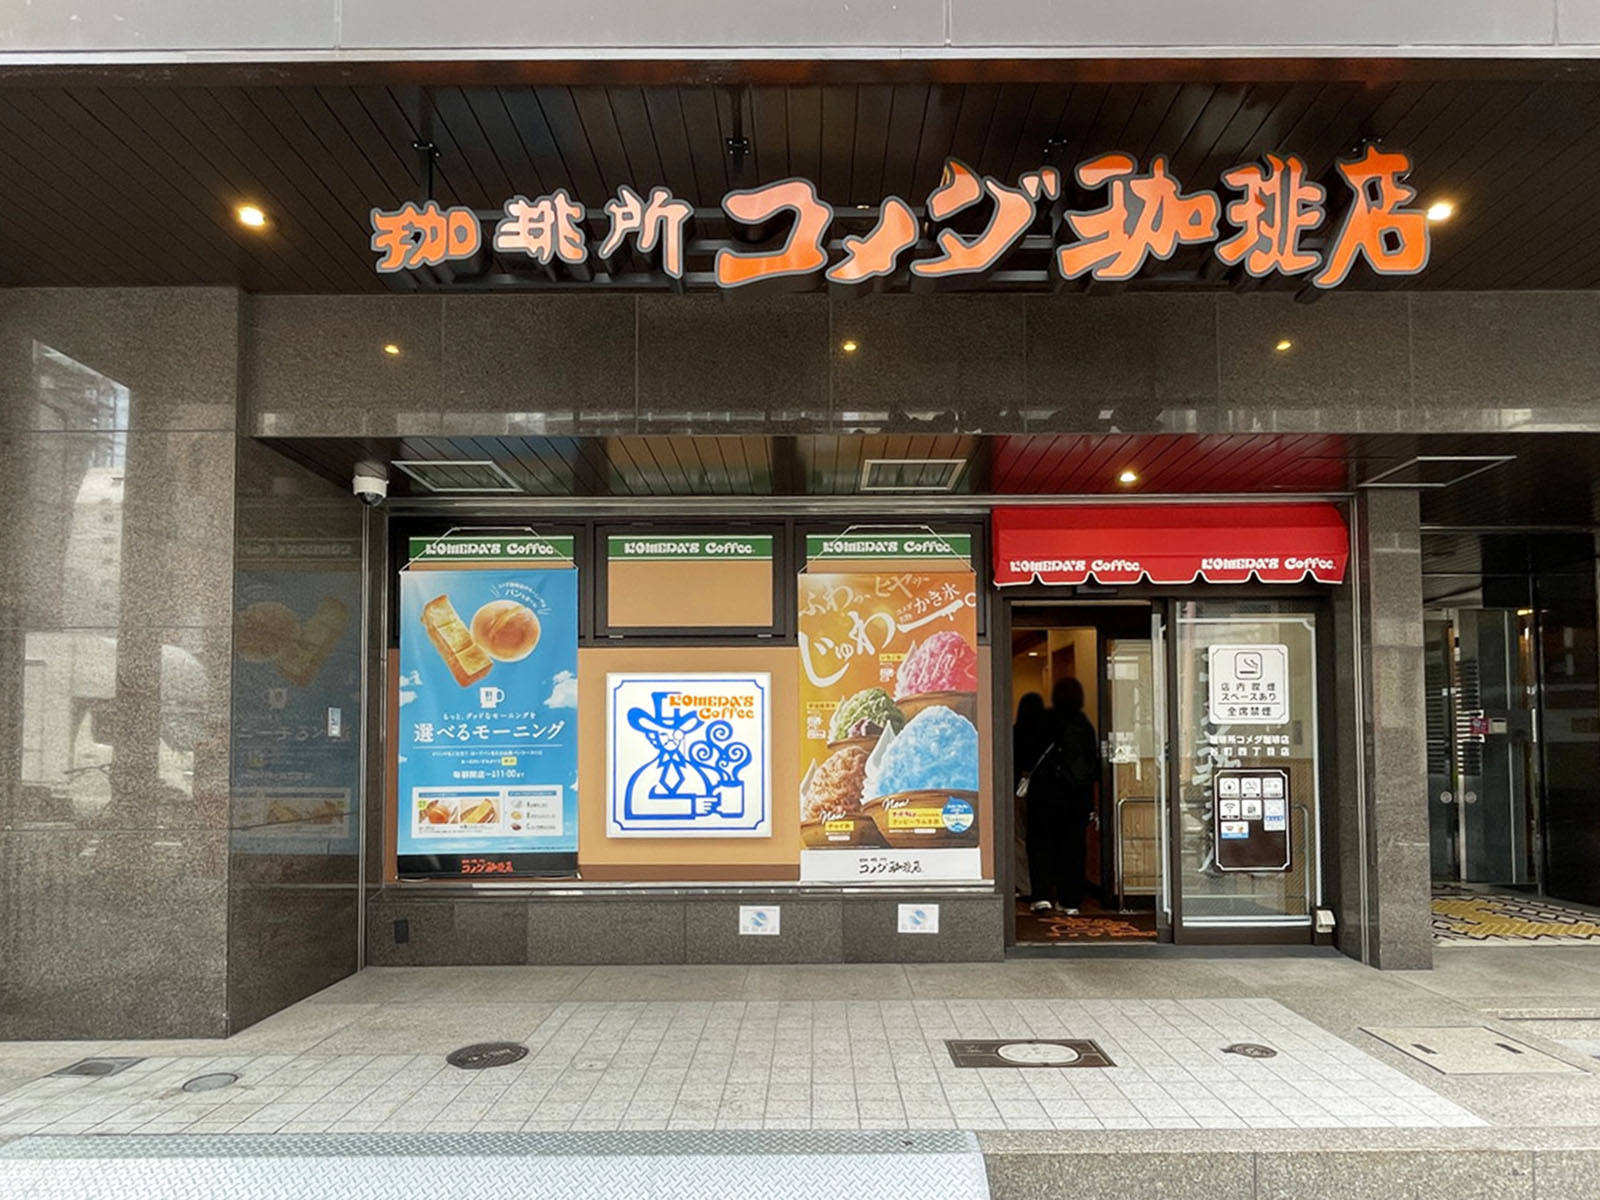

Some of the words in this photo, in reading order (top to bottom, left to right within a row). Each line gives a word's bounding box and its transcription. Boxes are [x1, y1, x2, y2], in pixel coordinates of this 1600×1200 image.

[714, 146, 1431, 289] コメダ珈琲店
[425, 542, 500, 554] KOMEDA'S
[507, 542, 554, 555] Coffee
[624, 542, 699, 554] KOMEDA'S
[705, 542, 752, 555] Coffee
[823, 541, 897, 553] KOMEDA'S
[903, 541, 950, 554] Coffee
[1010, 560, 1086, 572] KOMEDA'S
[1091, 560, 1140, 572] Coffee
[1201, 558, 1279, 570] KOMEDA'S
[1284, 558, 1333, 570] Coffee
[669, 695, 754, 708] KOMEDA'S
[1221, 692, 1277, 701] スペースあり
[699, 707, 754, 719] Coffee
[1228, 706, 1272, 716] 全席禁煙
[413, 720, 565, 743] 選べるモーニング
